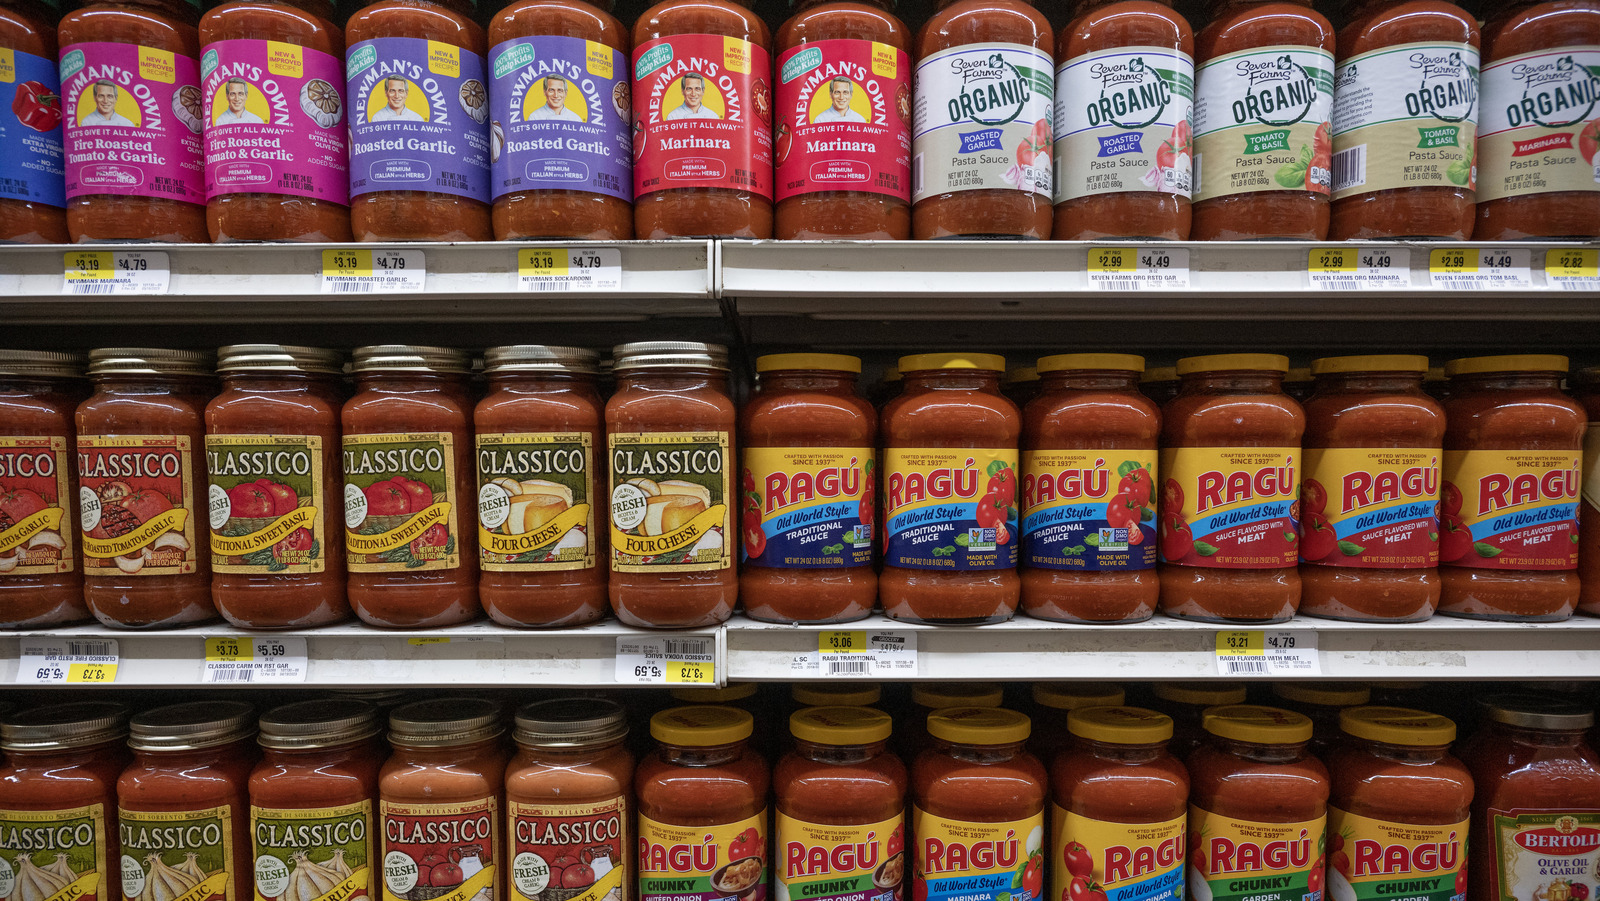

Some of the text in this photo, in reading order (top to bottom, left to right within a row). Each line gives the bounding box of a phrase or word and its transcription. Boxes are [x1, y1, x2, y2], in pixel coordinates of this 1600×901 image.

[508, 45, 530, 62] Profits
[269, 57, 302, 67] IMPROVED
[501, 54, 532, 74] Help Kids
[951, 58, 987, 75] Seven
[1236, 60, 1276, 77] Seven
[963, 68, 1003, 84] Farms
[1248, 70, 1292, 86] Farms
[1512, 64, 1555, 80] Seven
[1525, 72, 1573, 88] Farms
[67, 64, 162, 131] NEWMAN'S OWN
[206, 62, 290, 130] NEWMAN'S OWN
[357, 59, 448, 126] NEWMAN'S OWN
[510, 59, 603, 126] NEWMAN'S OWN
[650, 57, 741, 124] NEWMAN'S OWN
[796, 61, 867, 127] NEWMAN'S
[867, 80, 887, 127] OWN
[1405, 77, 1477, 117] ORGANIC
[948, 78, 1030, 122] ORGANIC
[1087, 80, 1171, 126] ORGANIC
[1232, 78, 1317, 124] ORGANIC
[1506, 77, 1600, 128] ORGANIC
[562, 124, 577, 132] ALL
[74, 139, 152, 151] Fire Roasted
[660, 135, 731, 151] Marinara
[965, 131, 1000, 143] ROASTED
[1250, 133, 1285, 144] TOMATO
[1519, 137, 1567, 152] MARINARA
[355, 138, 456, 155] Roasted Garlic
[507, 138, 610, 156] Roasted Garlic
[806, 138, 876, 153] Marinara
[968, 140, 996, 151] GARLIC
[1262, 141, 1284, 150] BASIL
[69, 151, 166, 165] Tomato & Garlic
[952, 155, 1009, 166] Pasta Sauce
[1236, 155, 1296, 167] Pasta Sauce
[1510, 156, 1577, 170] Pasta Sauce
[965, 170, 972, 178] 24
[76, 260, 99, 270] $3.19
[119, 259, 147, 271] $4.79
[530, 257, 553, 268] $3.19
[573, 256, 601, 268] $4.79
[1099, 256, 1122, 267] $2.99
[1142, 256, 1170, 268] $4.49
[1320, 256, 1343, 267] $2.99
[1363, 256, 1391, 268] $4.49
[1561, 257, 1583, 268] $2.82
[78, 453, 180, 478] CLASSICO
[208, 451, 310, 475] CLASSICO
[343, 448, 443, 474] CLASSICO
[480, 450, 584, 474] CLASSICO
[614, 450, 721, 475] CLASSICO
[765, 456, 860, 516] RAGÚ
[888, 457, 980, 515] RAGÚ
[1023, 458, 1110, 513] RAGÚ
[1196, 455, 1295, 515] RAGÚ
[1341, 456, 1439, 515] RAGÚ
[1477, 459, 1579, 517] RAGÚ
[612, 496, 645, 514] FRESH
[777, 505, 849, 531] Old World Style
[254, 512, 309, 547] SWEET BASIL
[786, 522, 842, 540] TRADITIONAL
[1216, 530, 1236, 542] SAUCE
[1238, 523, 1270, 535] FLAVORED
[626, 524, 700, 552] FOUR CHEESE
[800, 532, 829, 545] SAUCE
[1238, 532, 1266, 545] MEAT
[216, 645, 239, 655] $3.73
[258, 645, 285, 656] $5.59
[830, 637, 852, 648] $3.06
[1227, 637, 1248, 648] $3.21
[1269, 637, 1295, 648] $4.79
[37, 668, 64, 679] $5.59
[83, 670, 105, 680] $3.73
[635, 666, 662, 677] $5.59
[681, 668, 703, 678] $3.73
[257, 819, 365, 848] CLASSICO
[387, 816, 490, 844] CLASSICO
[517, 817, 619, 845] CLASSICO
[1240, 830, 1262, 838] SINCE
[640, 834, 718, 873] RAGÚ
[787, 831, 879, 879] RAGÚ
[924, 829, 1019, 875] RAGÚ
[1103, 822, 1185, 885] RAGÚ
[1210, 828, 1311, 875] RAGÚ
[1353, 831, 1459, 877] RAGÚ
[1538, 859, 1570, 867] OLIVE
[1550, 867, 1587, 875] GARLIC
[514, 865, 548, 878] FRESH
[802, 879, 860, 895] CHUNKY
[934, 877, 1005, 892] Old World Style
[1229, 877, 1292, 892] CHUNKY
